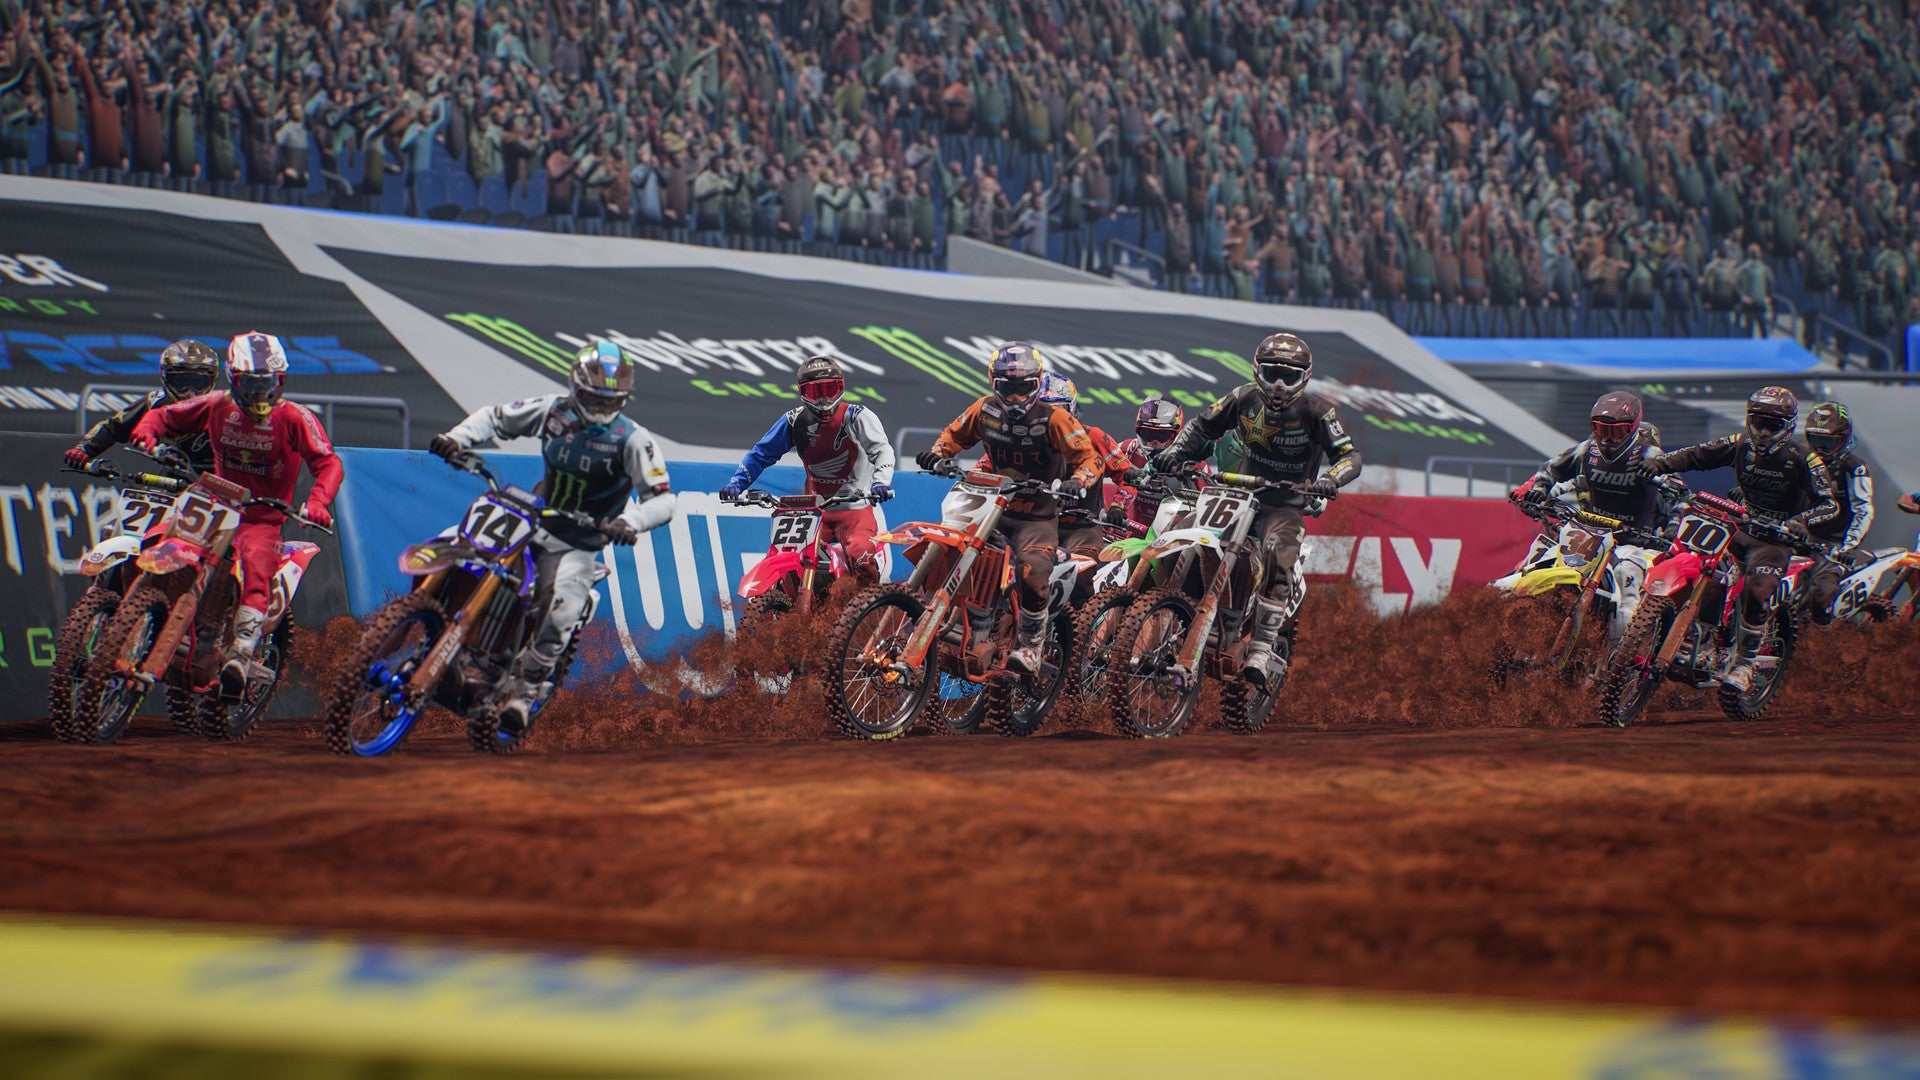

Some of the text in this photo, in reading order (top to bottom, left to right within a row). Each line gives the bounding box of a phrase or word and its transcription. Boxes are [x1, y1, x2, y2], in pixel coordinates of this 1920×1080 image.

[943, 335, 1218, 384] MNSTER
[690, 379, 887, 403] ENEGY
[220, 435, 274, 451] GASGAS
[810, 476, 859, 486] HONDA
[1589, 468, 1637, 487] THOR
[1753, 467, 1785, 478] HONDA
[122, 500, 169, 533] 21
[178, 496, 229, 546] 51
[944, 494, 987, 524] 2
[1199, 497, 1240, 529] 16
[468, 503, 522, 552] 14
[773, 517, 814, 545] 23
[1678, 518, 1726, 551] 10
[1559, 530, 1603, 563] 34
[1301, 535, 1463, 618] FLY
